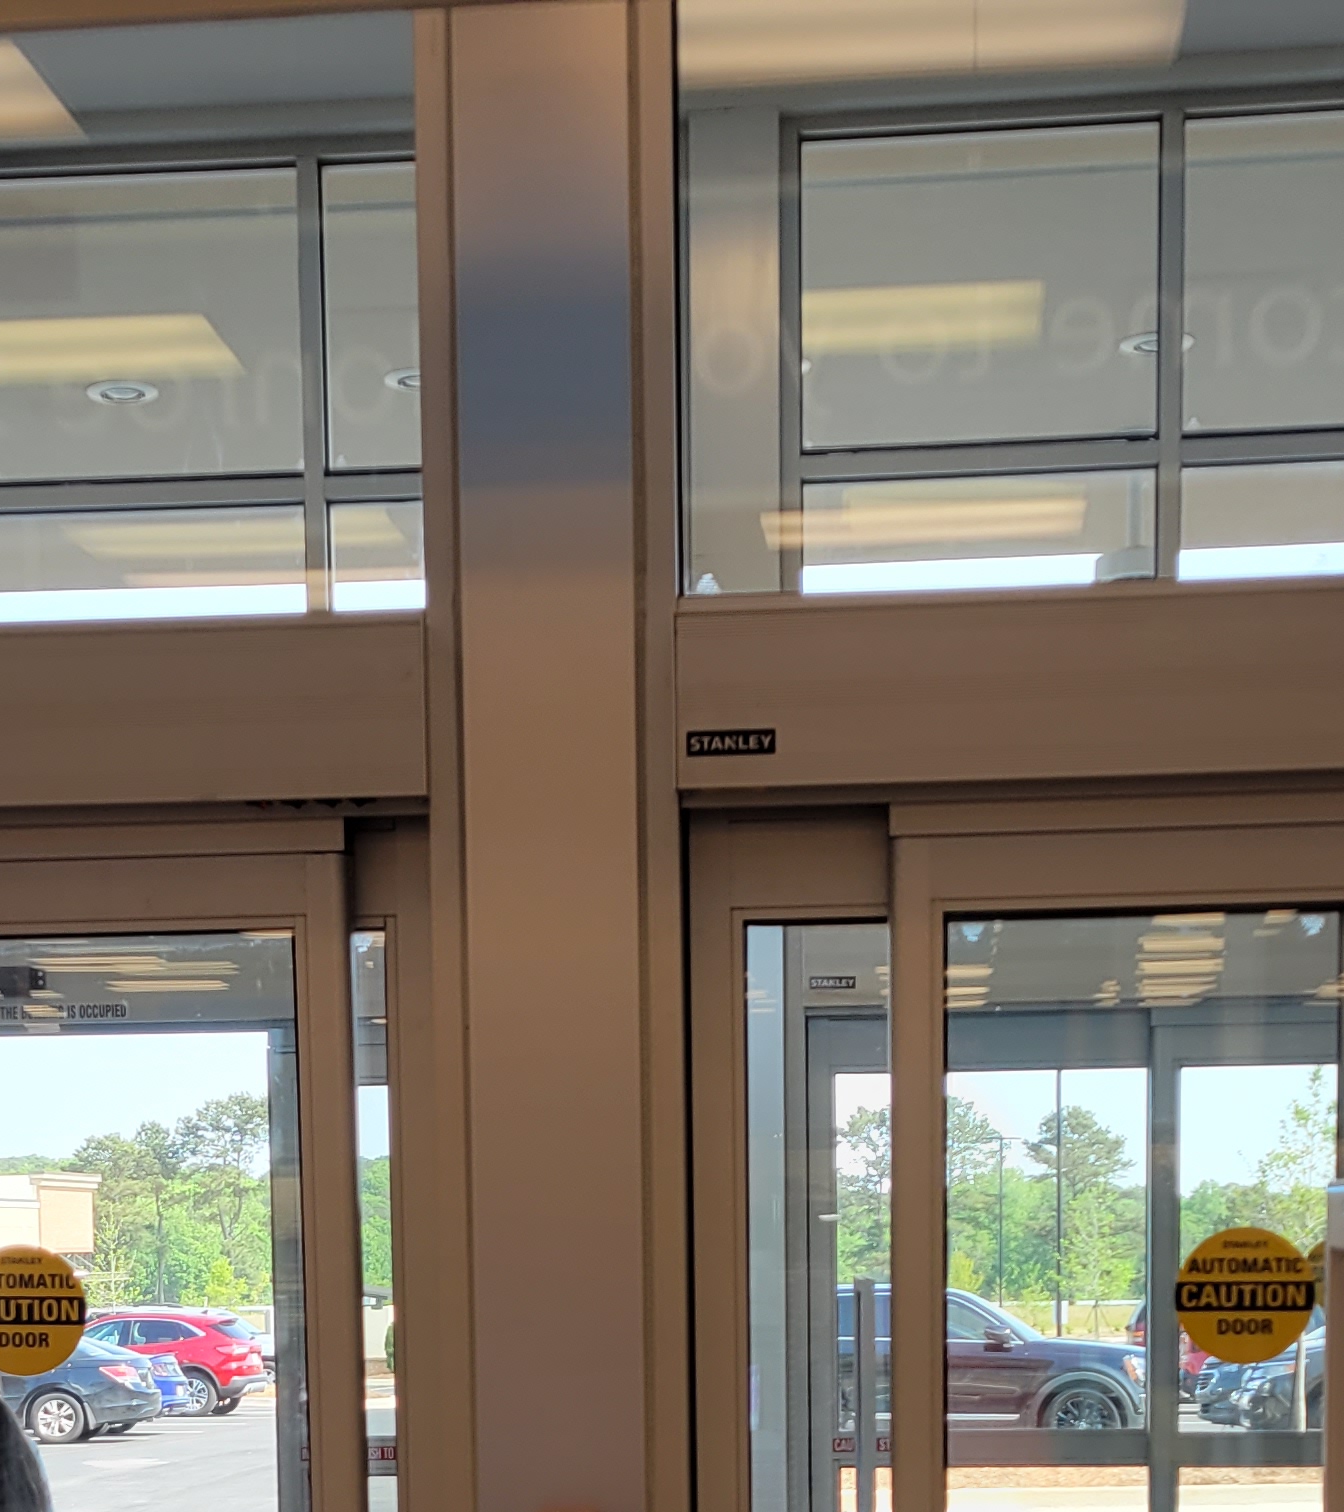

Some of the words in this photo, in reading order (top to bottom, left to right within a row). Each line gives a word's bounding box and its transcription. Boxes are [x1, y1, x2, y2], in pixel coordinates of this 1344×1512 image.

[689, 734, 773, 752] STANLEY
[810, 978, 855, 988] STANLEY
[67, 1005, 77, 1019] IS
[79, 1004, 128, 1018] OCCUPIED
[1188, 1256, 1304, 1275] AUTOMATIC
[1180, 1284, 1307, 1308] CAUTION
[1216, 1317, 1274, 1336] DOOR
